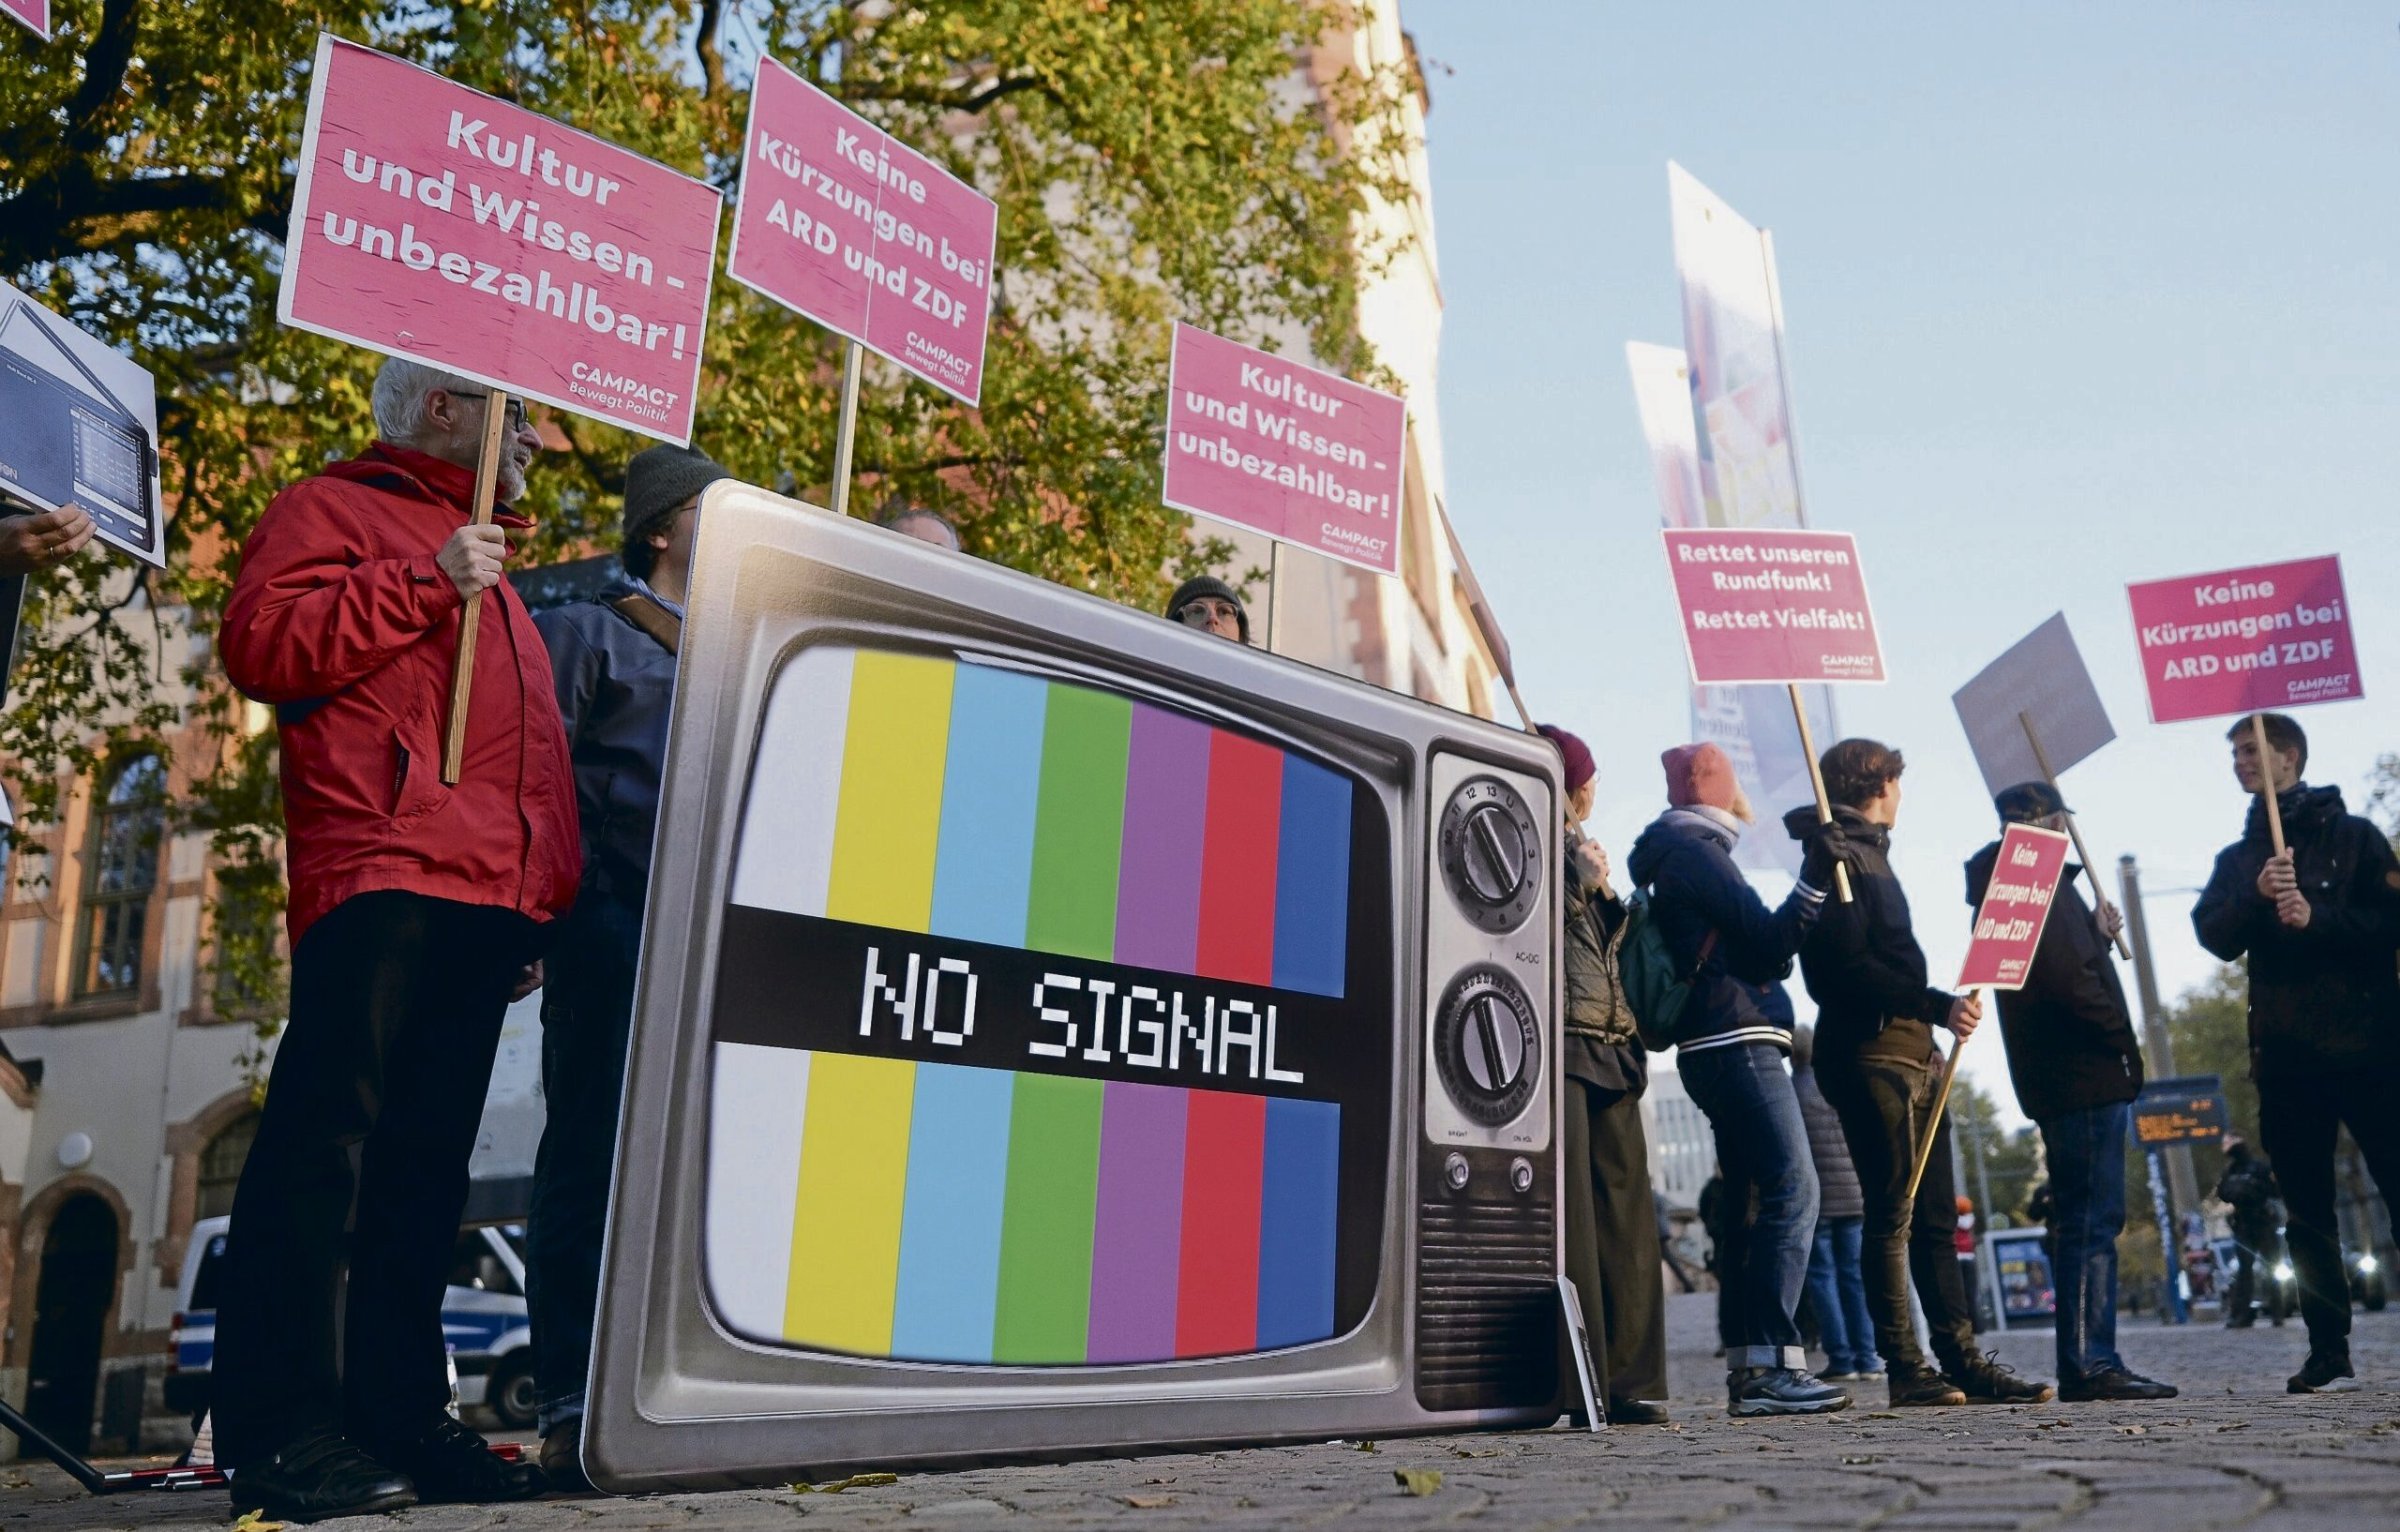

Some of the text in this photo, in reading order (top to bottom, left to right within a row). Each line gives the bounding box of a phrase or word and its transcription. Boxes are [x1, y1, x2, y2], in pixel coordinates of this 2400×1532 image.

[446, 110, 620, 206] Kultur
[836, 126, 926, 204] Keine
[342, 148, 456, 212] und
[468, 183, 654, 288] Wissen
[757, 129, 985, 289] Kürzungen bei
[765, 198, 967, 329] ARD und ZDF
[322, 211, 686, 361] unbezahlbar!
[904, 346, 966, 387] Bewegt Politik
[906, 331, 973, 376] CAMPACT
[569, 381, 668, 423] Bewegt Politik
[571, 361, 679, 409] CAMPACT
[1240, 362, 1342, 418] Kultur
[1185, 391, 1249, 429] und
[1254, 409, 1366, 470] Wissen
[1178, 431, 1390, 518] unbezahlbar!
[1321, 522, 1388, 553] CAMPACT
[1677, 543, 1849, 566] Rettet unseren
[1712, 569, 1832, 592] Rundfunk!
[2194, 578, 2274, 607] Keine
[1692, 607, 1866, 630] Rettet Vielfalt!
[2142, 599, 2342, 648] Kürzungen bei
[1821, 654, 1873, 666] CAMPACT
[2163, 639, 2334, 682] ARD und ZDF
[2287, 673, 2351, 692] CAMPACT
[1451, 803, 1462, 816] 11
[1465, 786, 1477, 800] 12
[1486, 785, 1497, 797] 13
[1528, 849, 1536, 858] 3
[2010, 842, 2039, 868] Keine
[1988, 877, 2052, 908] ürzungen bei
[1992, 917, 2014, 940] und
[2009, 919, 2034, 942] ZDF
[859, 947, 1305, 1084] NO SIGNAL
